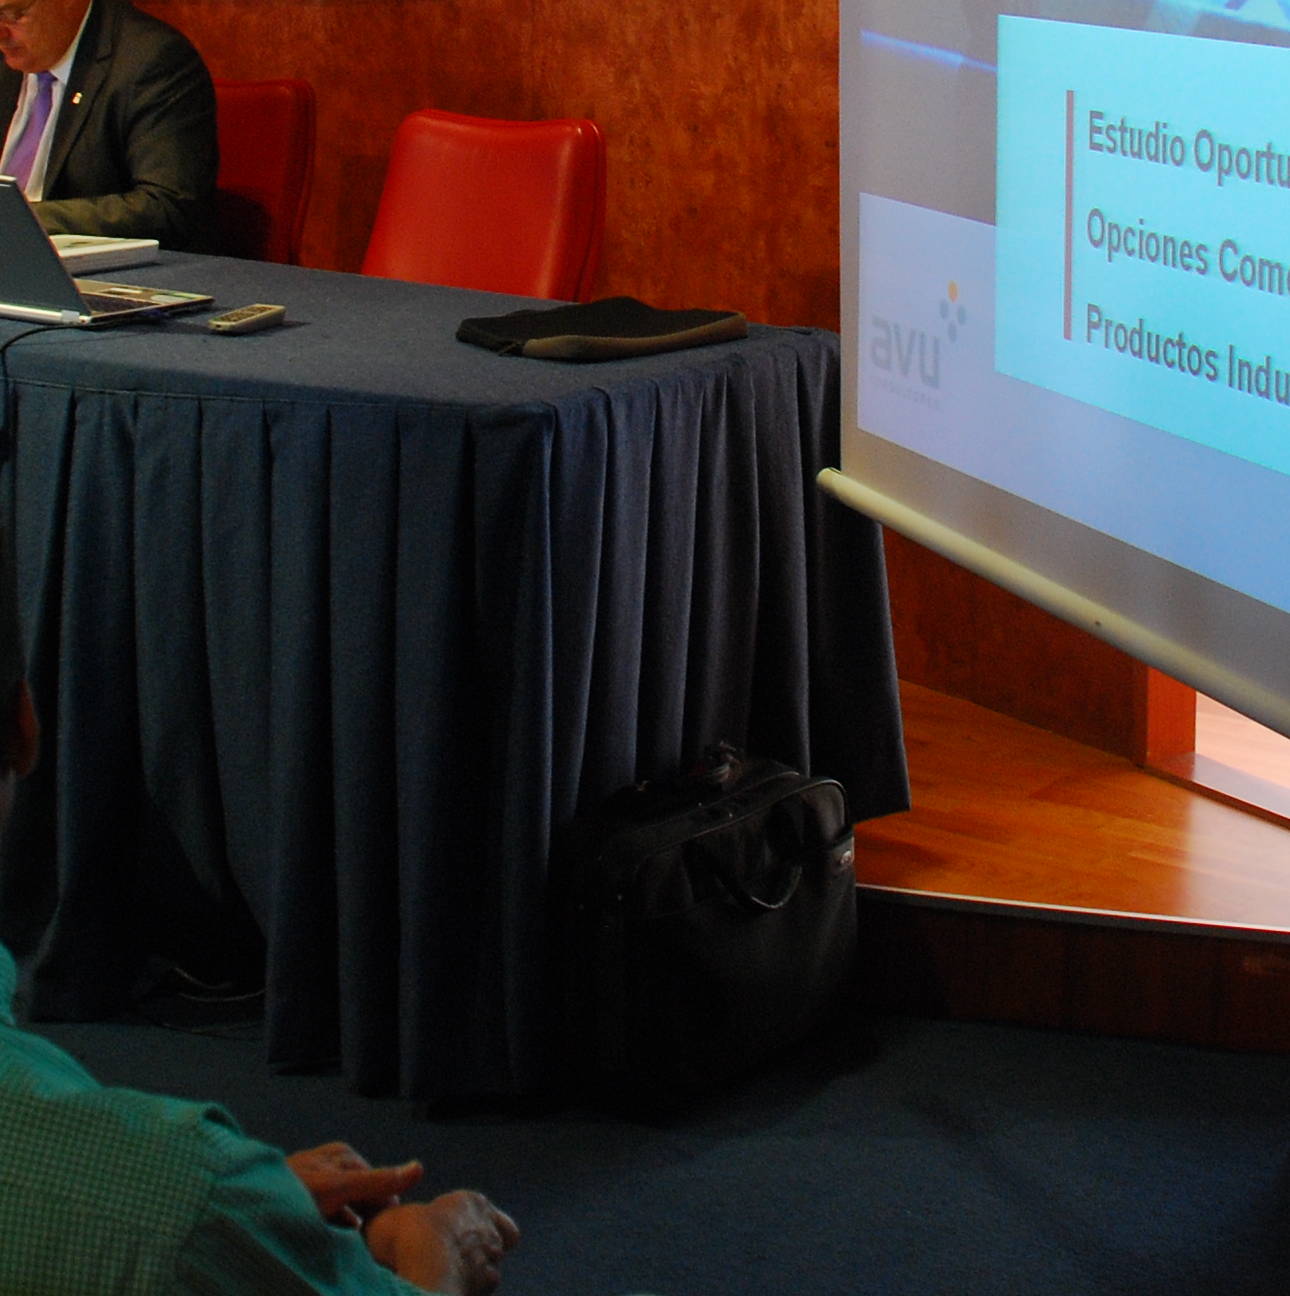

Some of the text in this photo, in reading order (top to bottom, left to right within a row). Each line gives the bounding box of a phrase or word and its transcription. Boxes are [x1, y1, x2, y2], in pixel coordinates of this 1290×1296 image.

[1088, 109, 1185, 167] Estudio
[1086, 206, 1208, 277] Opciones
[1086, 302, 1219, 382] Productos
